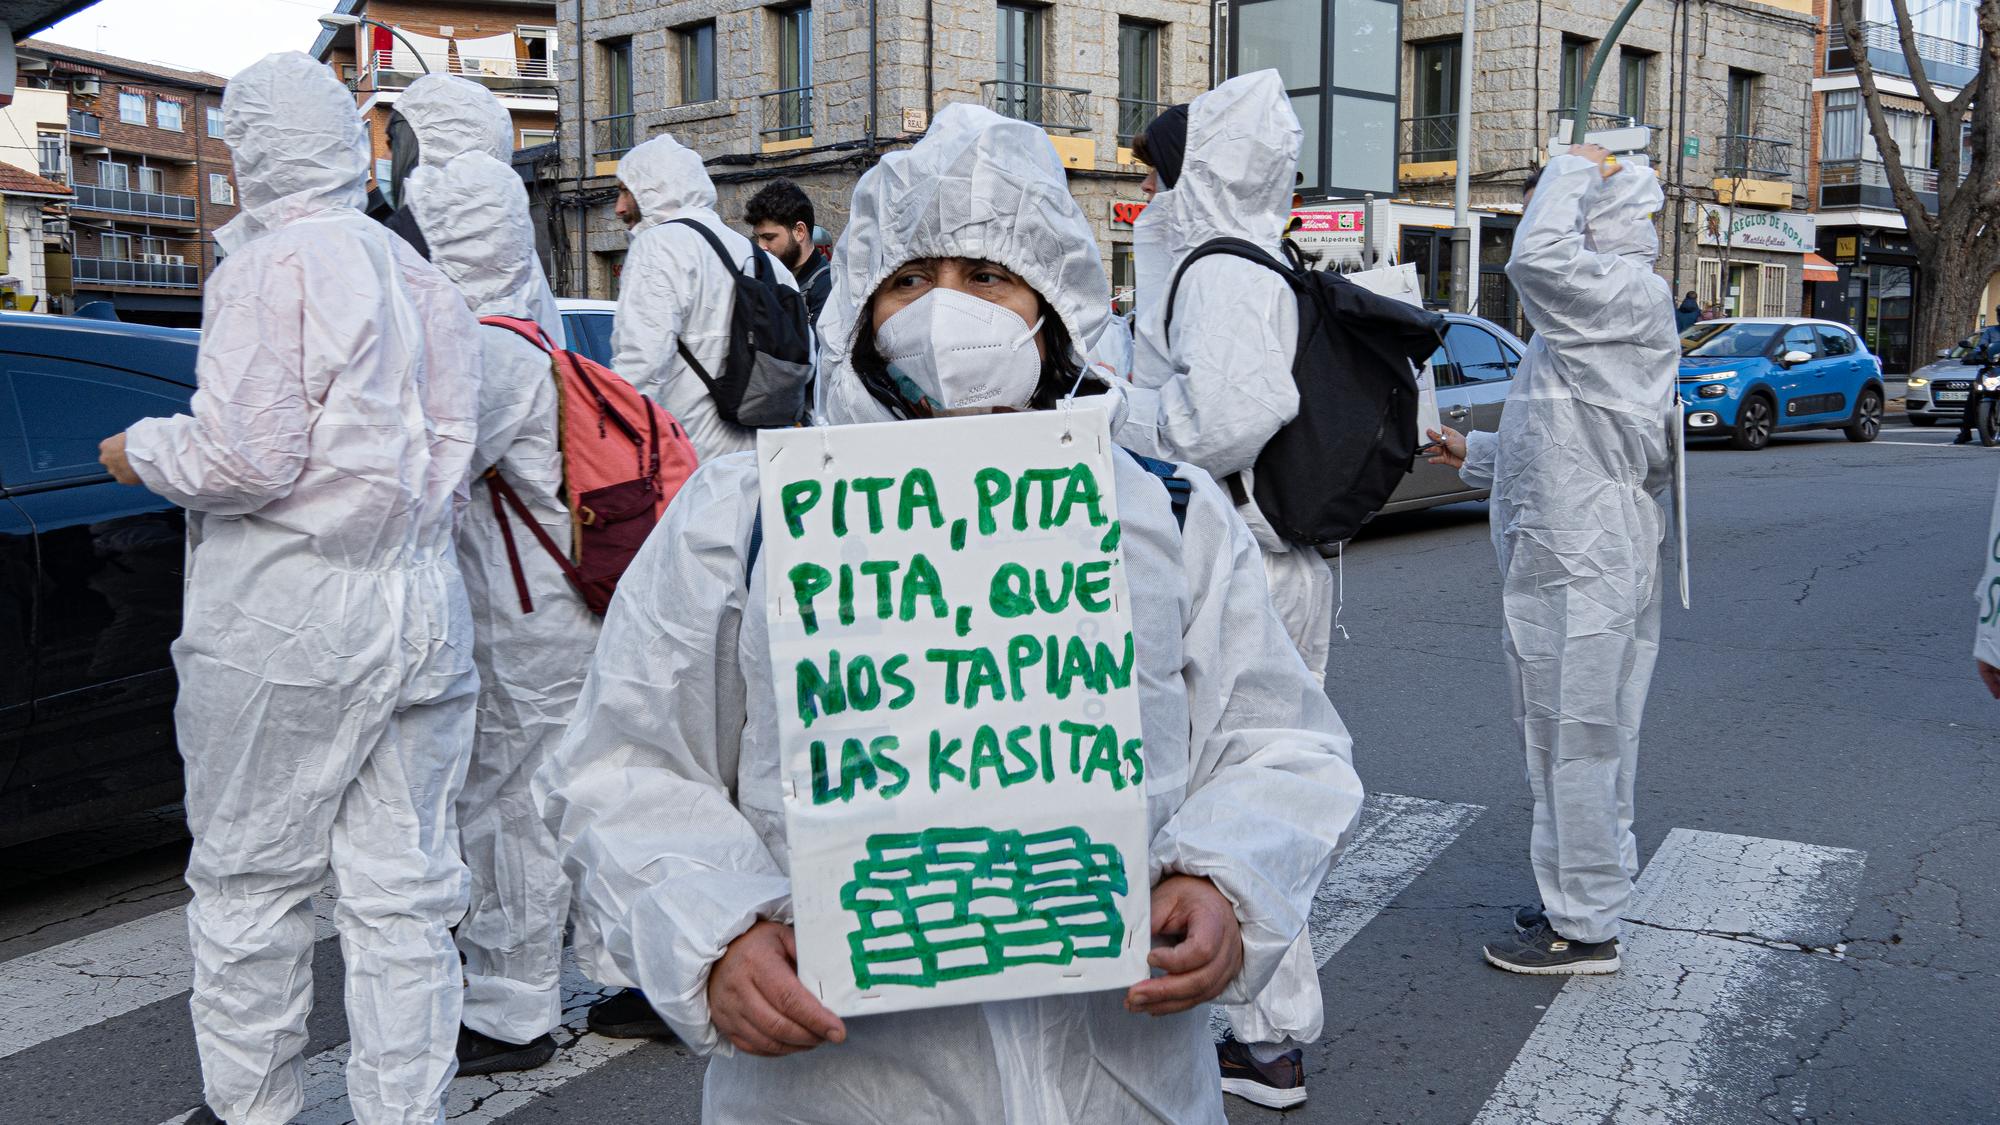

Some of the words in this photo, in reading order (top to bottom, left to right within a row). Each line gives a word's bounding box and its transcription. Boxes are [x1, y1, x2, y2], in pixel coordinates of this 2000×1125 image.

[907, 119, 923, 128] REAL
[1320, 236, 1357, 244] Alpedrete
[1724, 213, 1767, 242] AREGLOS
[1769, 215, 1780, 230] DE
[1782, 222, 1804, 249] ROPA
[780, 467, 968, 551] PITA,
[974, 463, 1121, 553] PITA,
[787, 553, 973, 637] PITA,
[796, 649, 915, 729] NOS
[925, 631, 1135, 709] TAPIAN
[809, 735, 911, 806] LAS
[928, 720, 1144, 793] KASITAS
